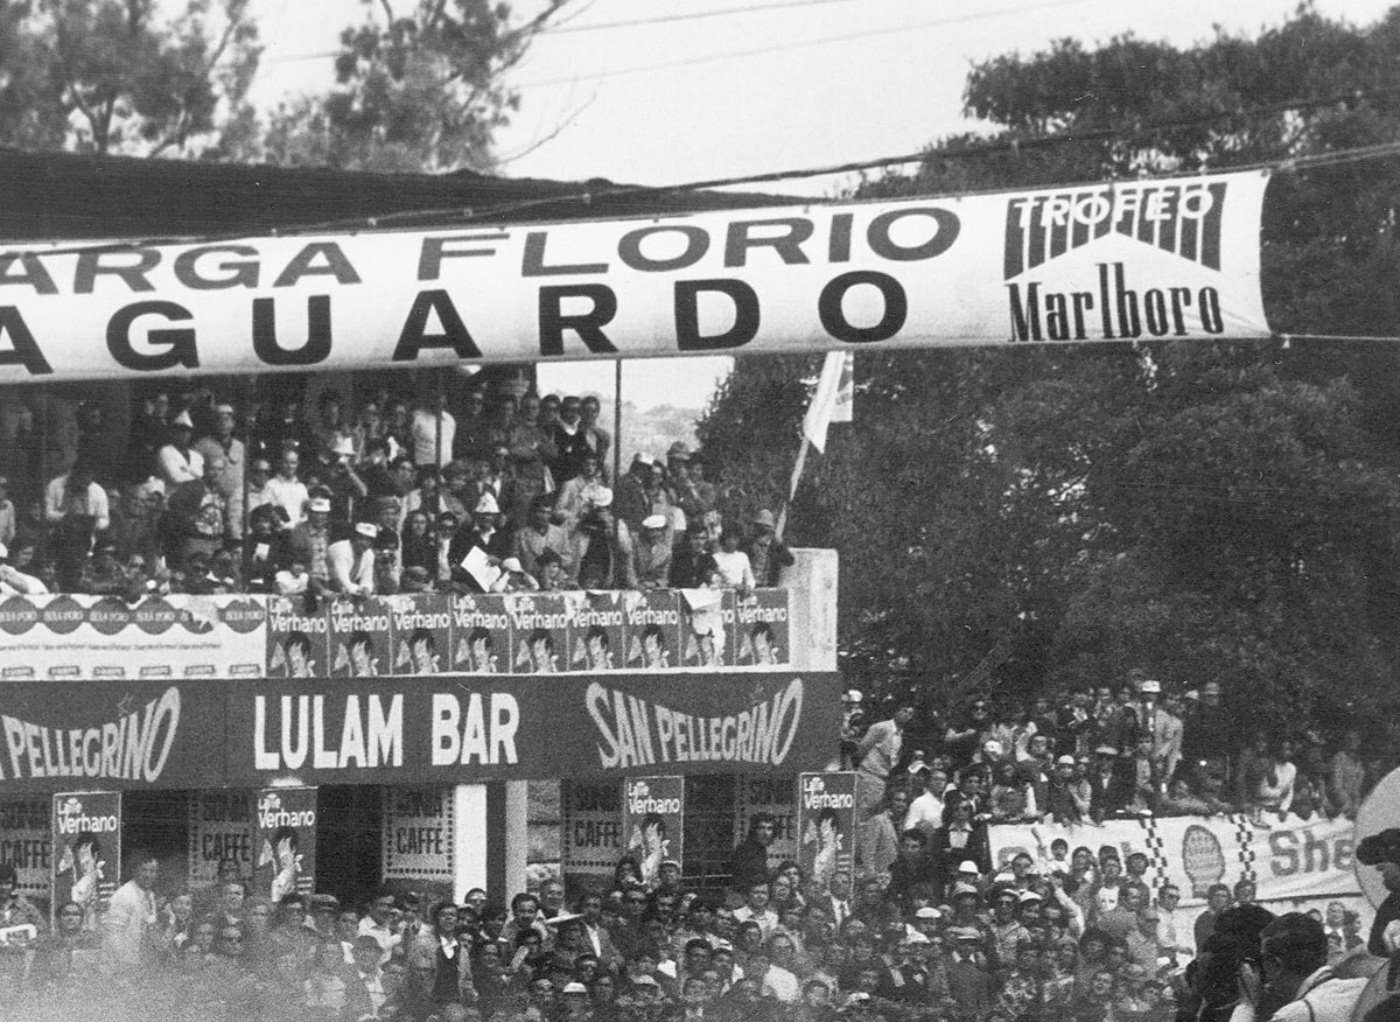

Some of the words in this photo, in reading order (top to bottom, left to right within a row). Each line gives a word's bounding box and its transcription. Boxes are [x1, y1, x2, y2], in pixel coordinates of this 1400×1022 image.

[417, 207, 961, 281] FLORIO
[1014, 189, 1214, 228] TROFEO
[1005, 261, 1225, 343] Marlboro
[1, 686, 181, 783] PELLEGRINO
[254, 693, 404, 770] LULAM
[431, 693, 520, 766] BAR
[586, 681, 655, 768] SAN
[654, 678, 803, 765] PELLEGRINO
[1268, 830, 1353, 876] She
